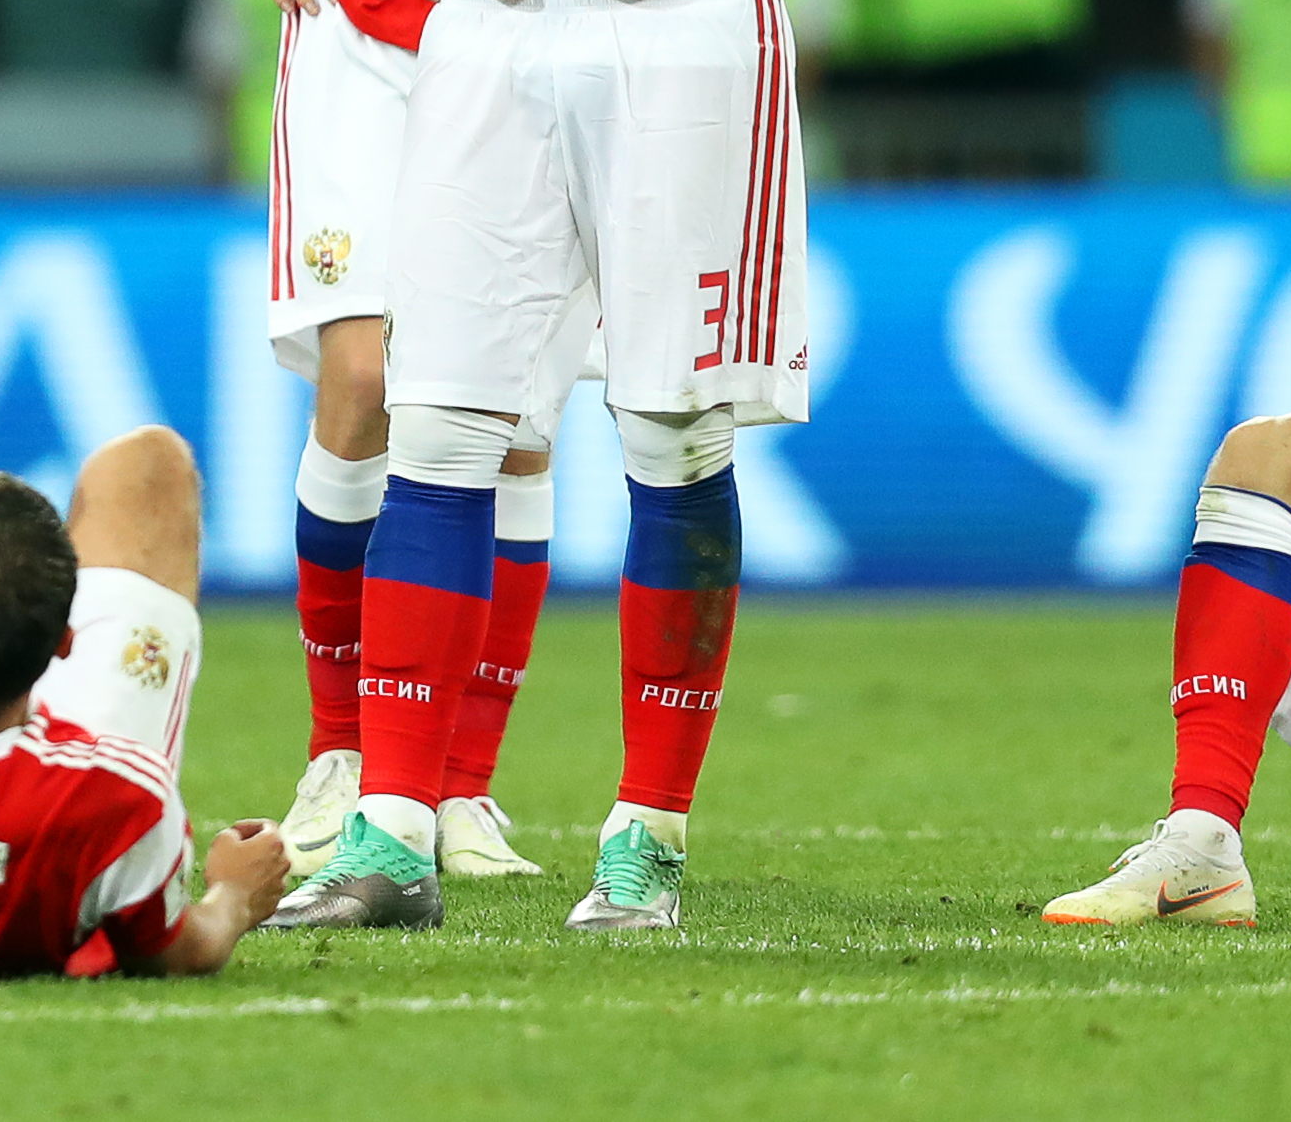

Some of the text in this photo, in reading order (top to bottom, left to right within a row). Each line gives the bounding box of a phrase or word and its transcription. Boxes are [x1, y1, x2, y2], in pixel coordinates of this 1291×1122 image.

[693, 269, 730, 372] 3
[357, 678, 432, 703] ОССИЯ
[1170, 674, 1247, 706] ОССИЯ
